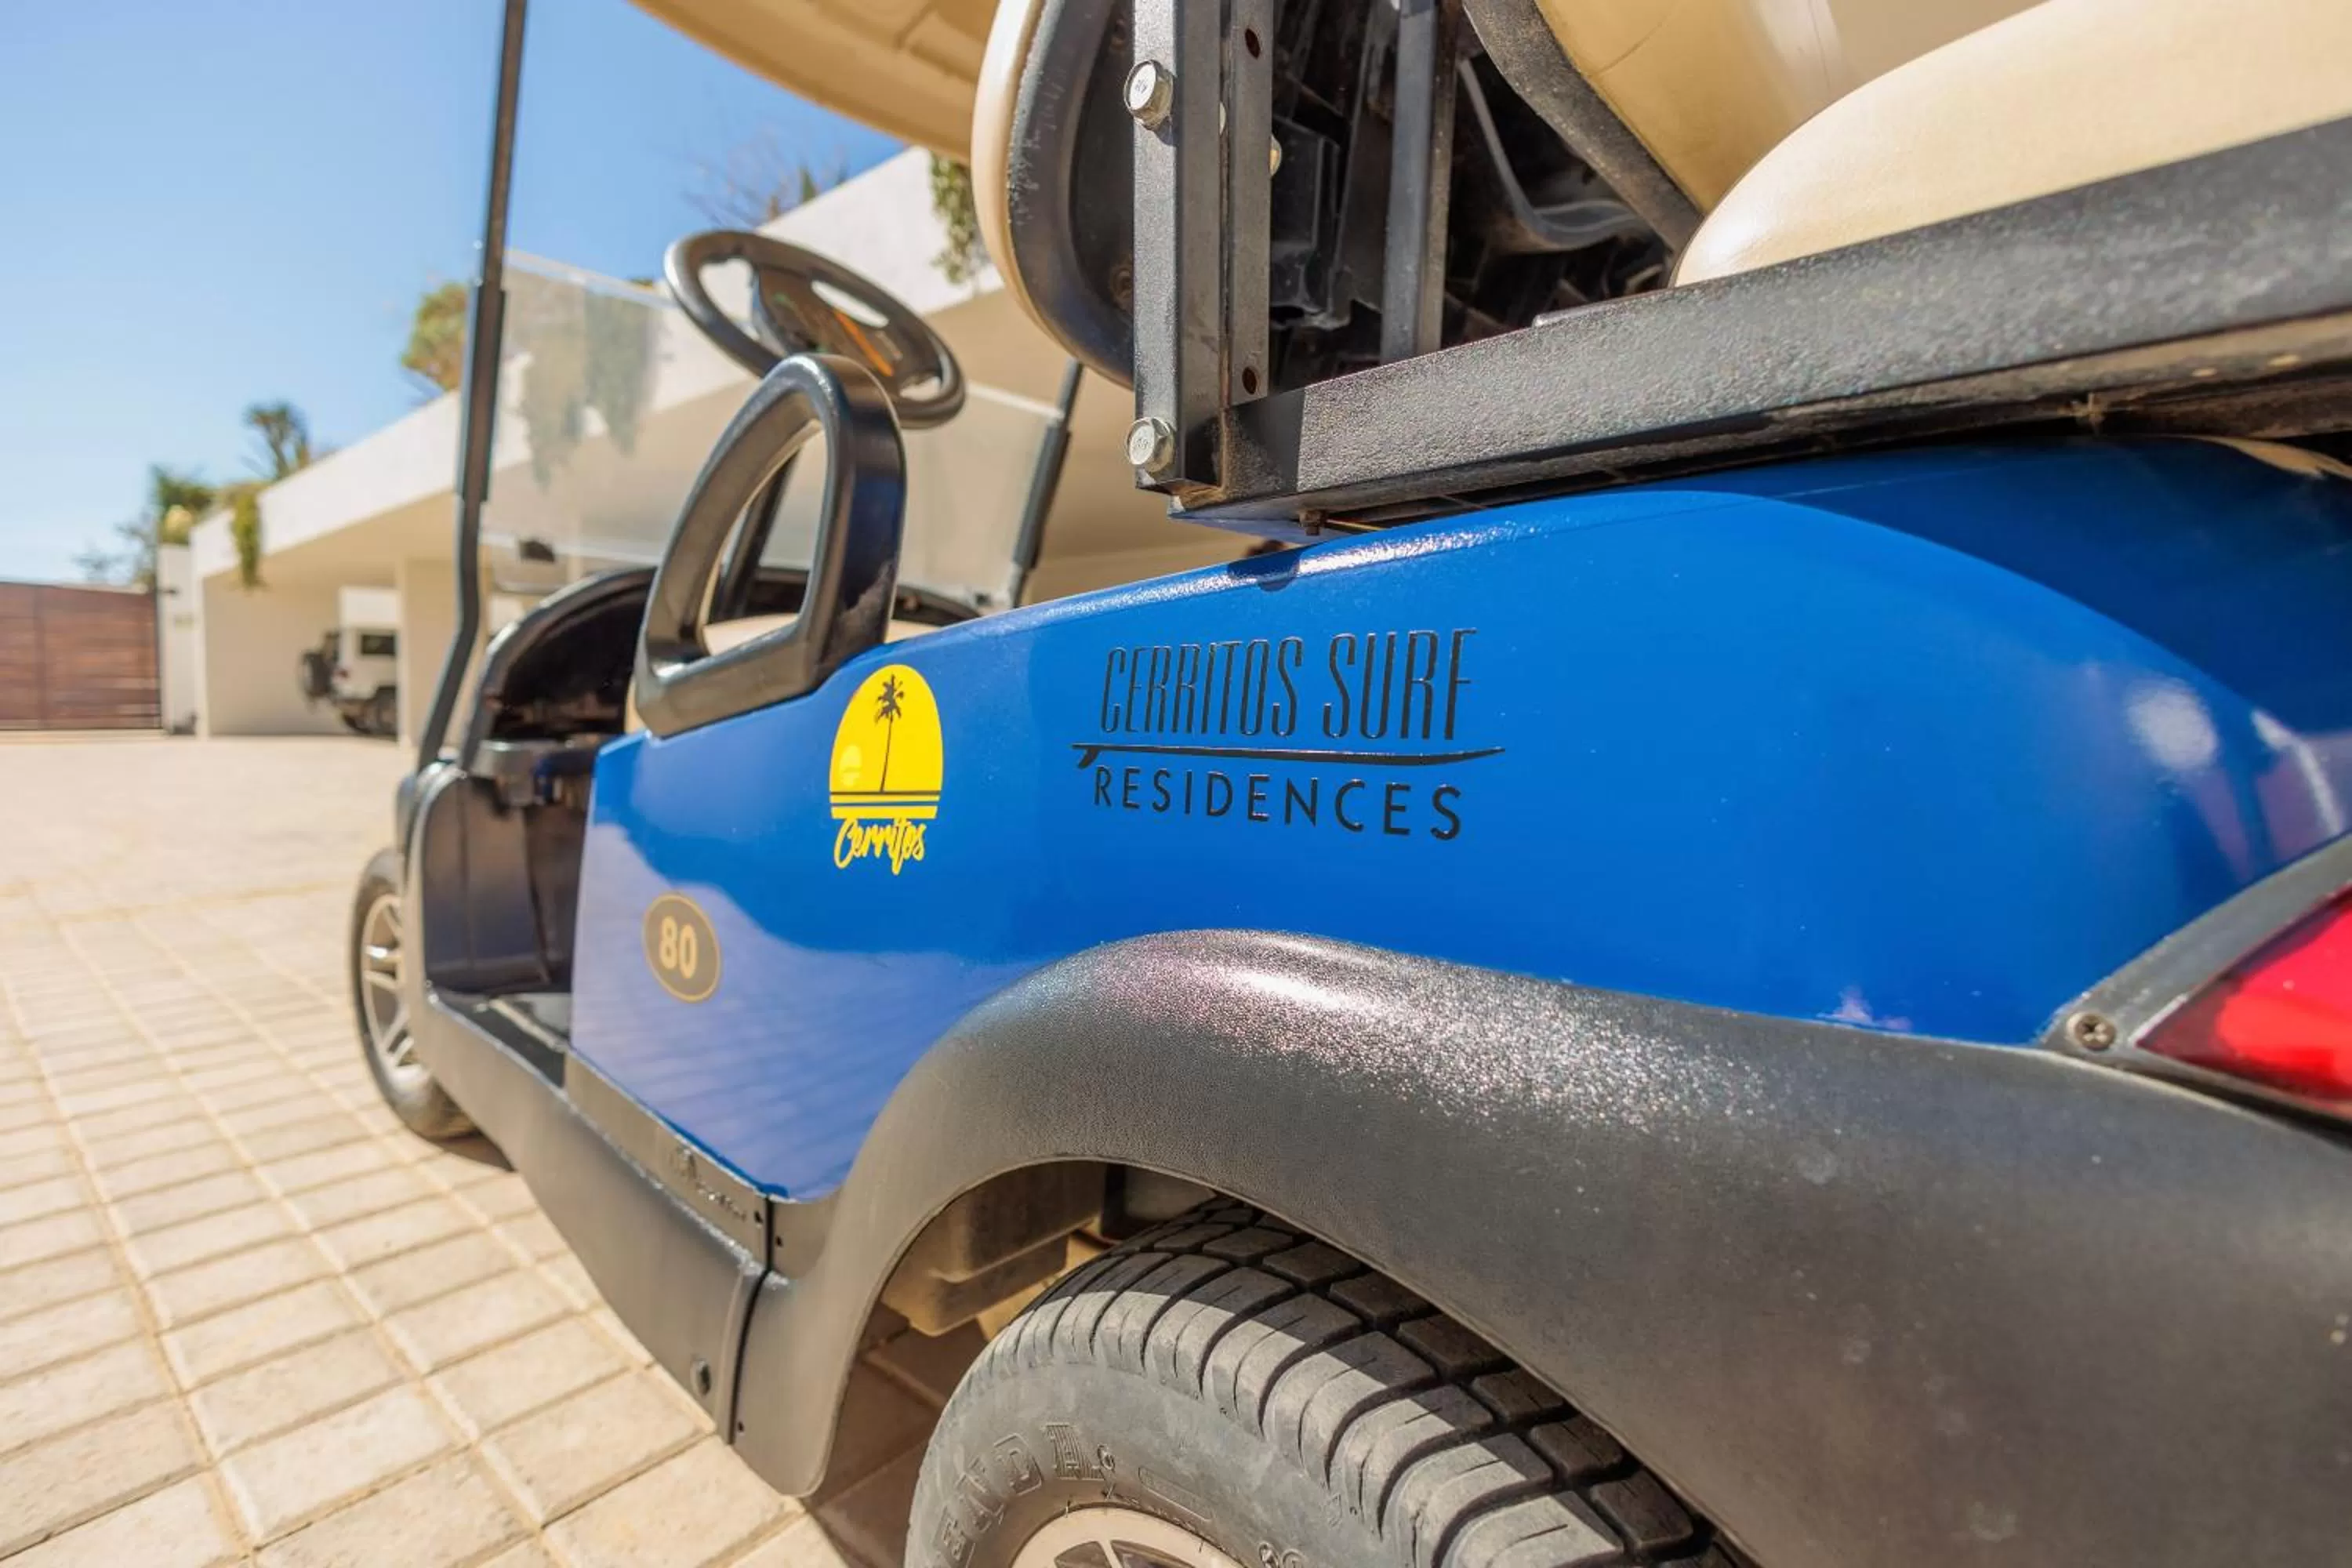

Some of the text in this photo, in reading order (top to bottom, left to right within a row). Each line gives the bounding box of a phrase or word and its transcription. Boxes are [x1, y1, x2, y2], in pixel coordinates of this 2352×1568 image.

[1100, 628, 1478, 741] CERRITOS SURF
[1094, 766, 1462, 841] RESIDENCES
[833, 817, 927, 876] Cerritos
[659, 916, 699, 979] 80
